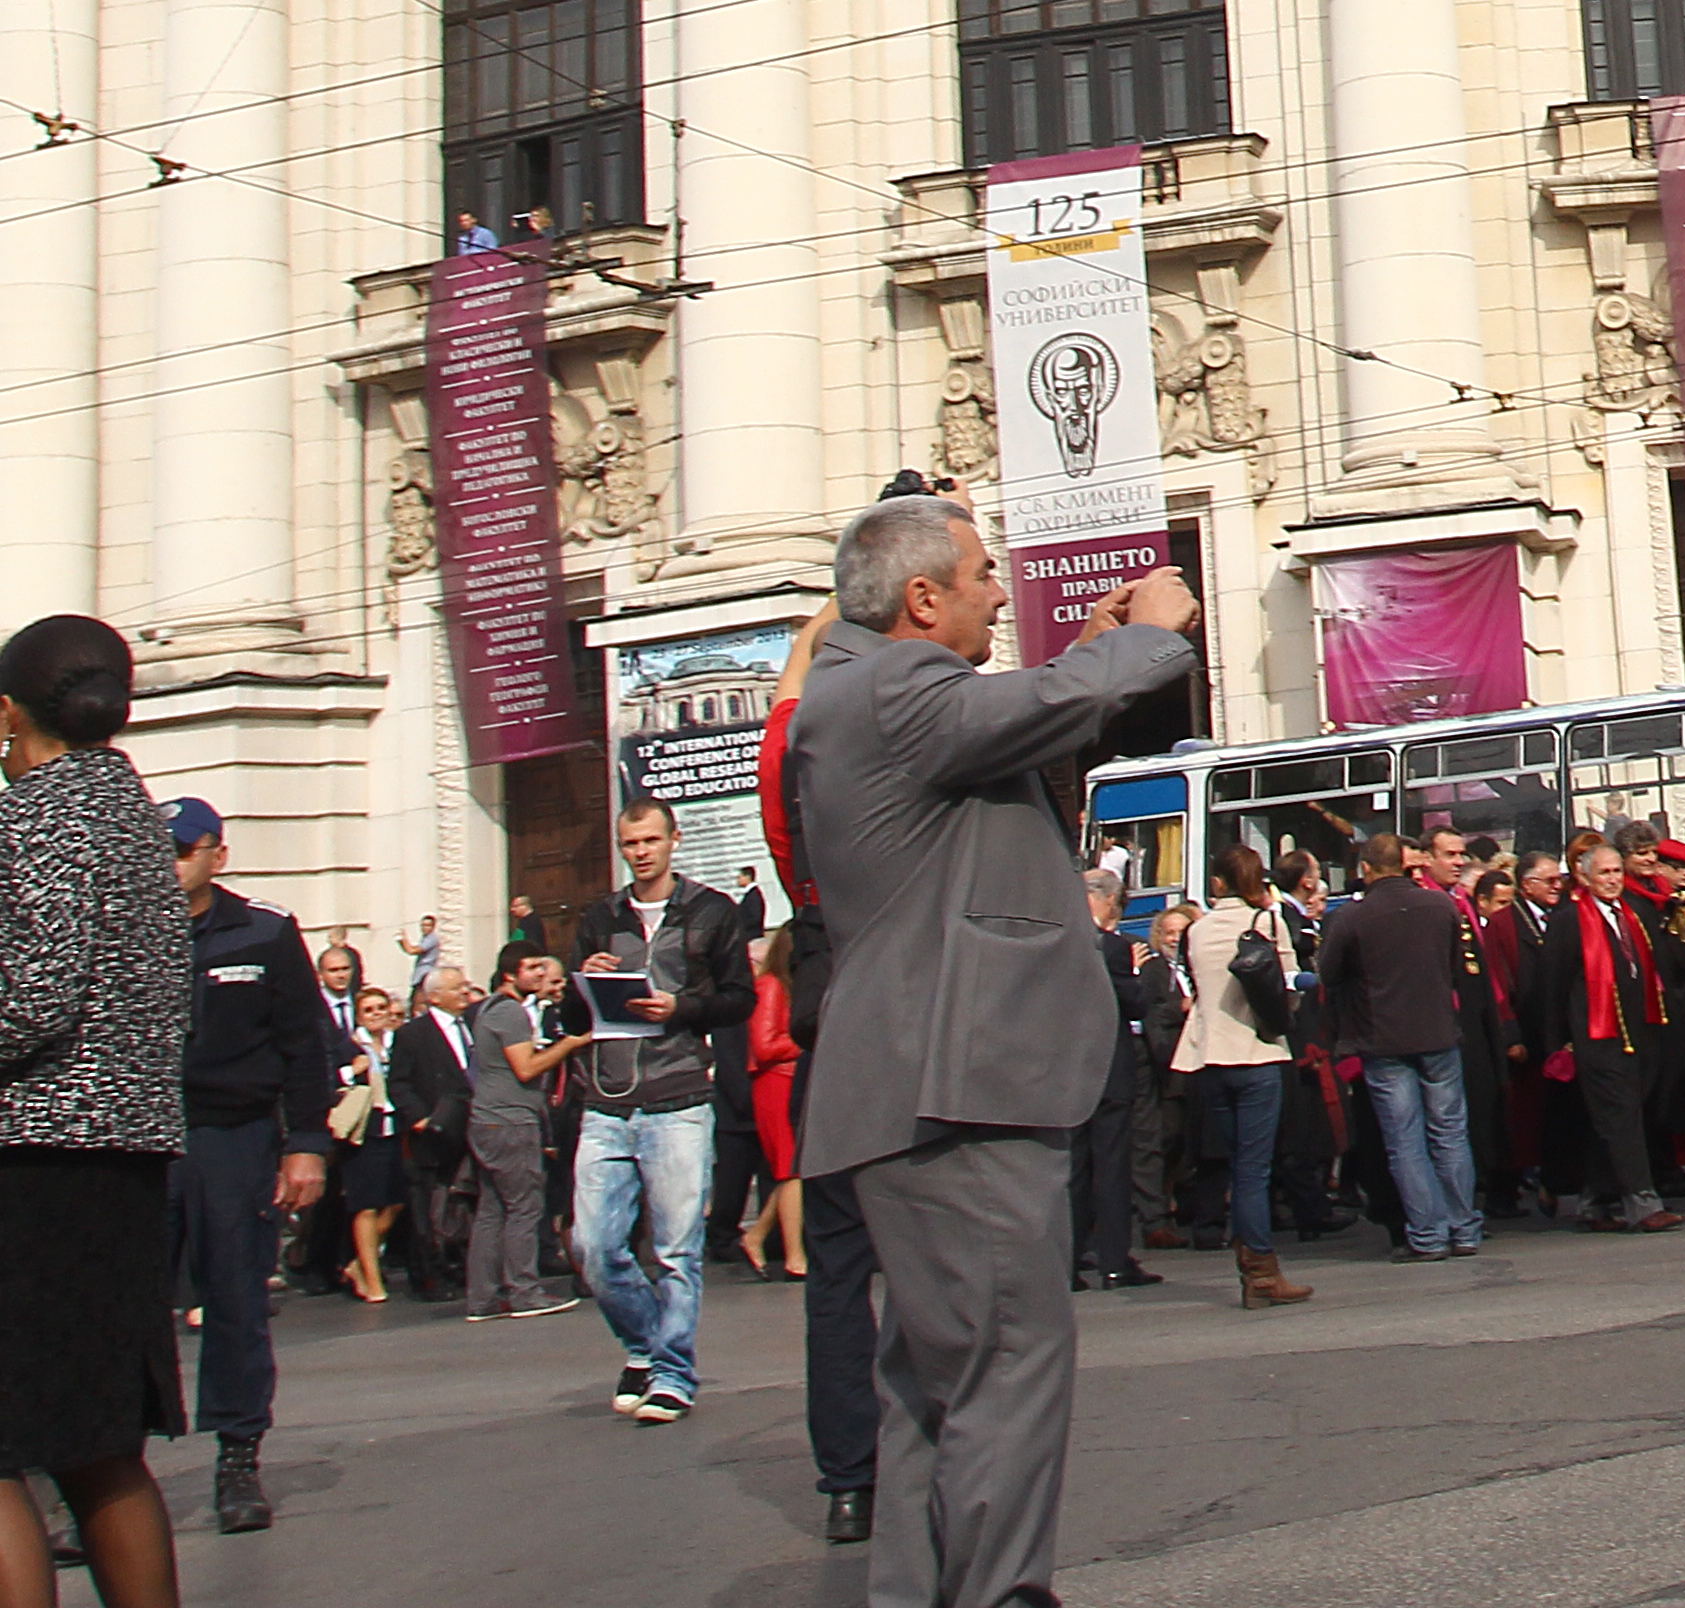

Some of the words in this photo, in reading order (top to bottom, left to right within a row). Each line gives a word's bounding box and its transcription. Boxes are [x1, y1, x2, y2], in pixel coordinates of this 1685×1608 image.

[1027, 192, 1101, 236] 125
[1003, 278, 1130, 306] СОФИЙСКИ
[996, 296, 1142, 327] УНИВЕРСИТЕТ
[1054, 484, 1155, 510] КЛИМЕНТ
[1023, 547, 1156, 580] ЗНАНИЕТО
[648, 749, 740, 771] CONFERENCE
[642, 769, 697, 787] GLOBAL
[652, 786, 683, 799] AND
